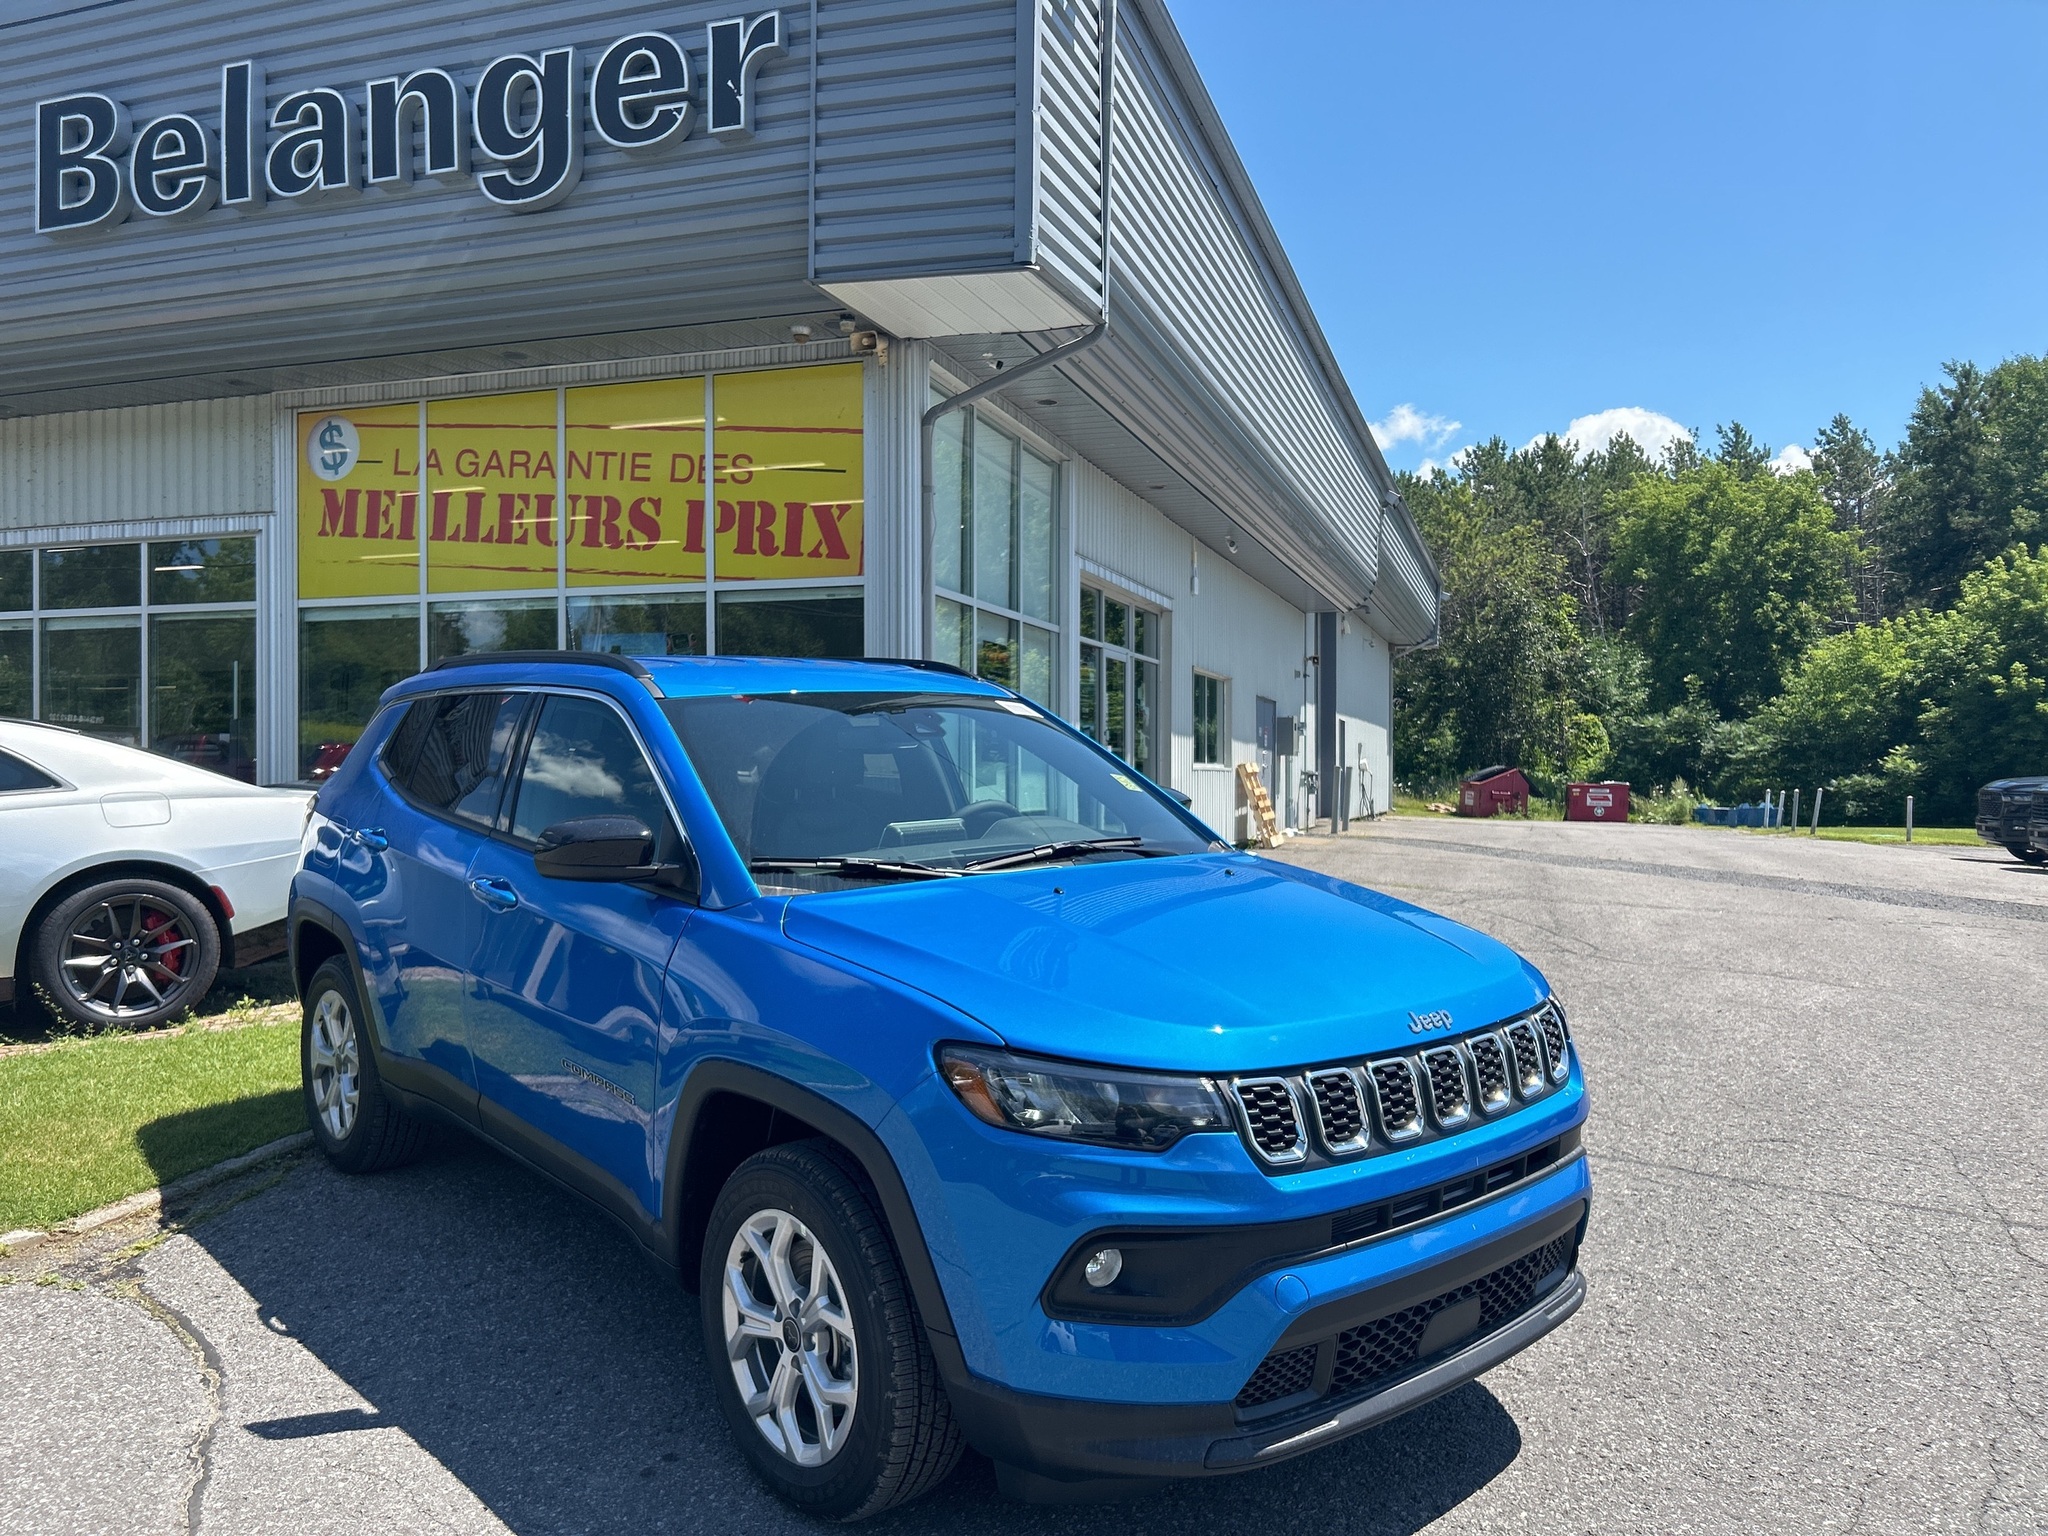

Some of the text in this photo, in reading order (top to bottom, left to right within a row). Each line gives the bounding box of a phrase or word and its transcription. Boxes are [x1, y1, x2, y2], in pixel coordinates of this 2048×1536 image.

[35, 10, 788, 235] Belanger
[393, 449, 754, 485] LA GARANTIE DES
[318, 488, 852, 559] MEILLEURS PRIX
[1408, 1009, 1453, 1034] Jeep
[561, 1057, 636, 1105] COMPASS
